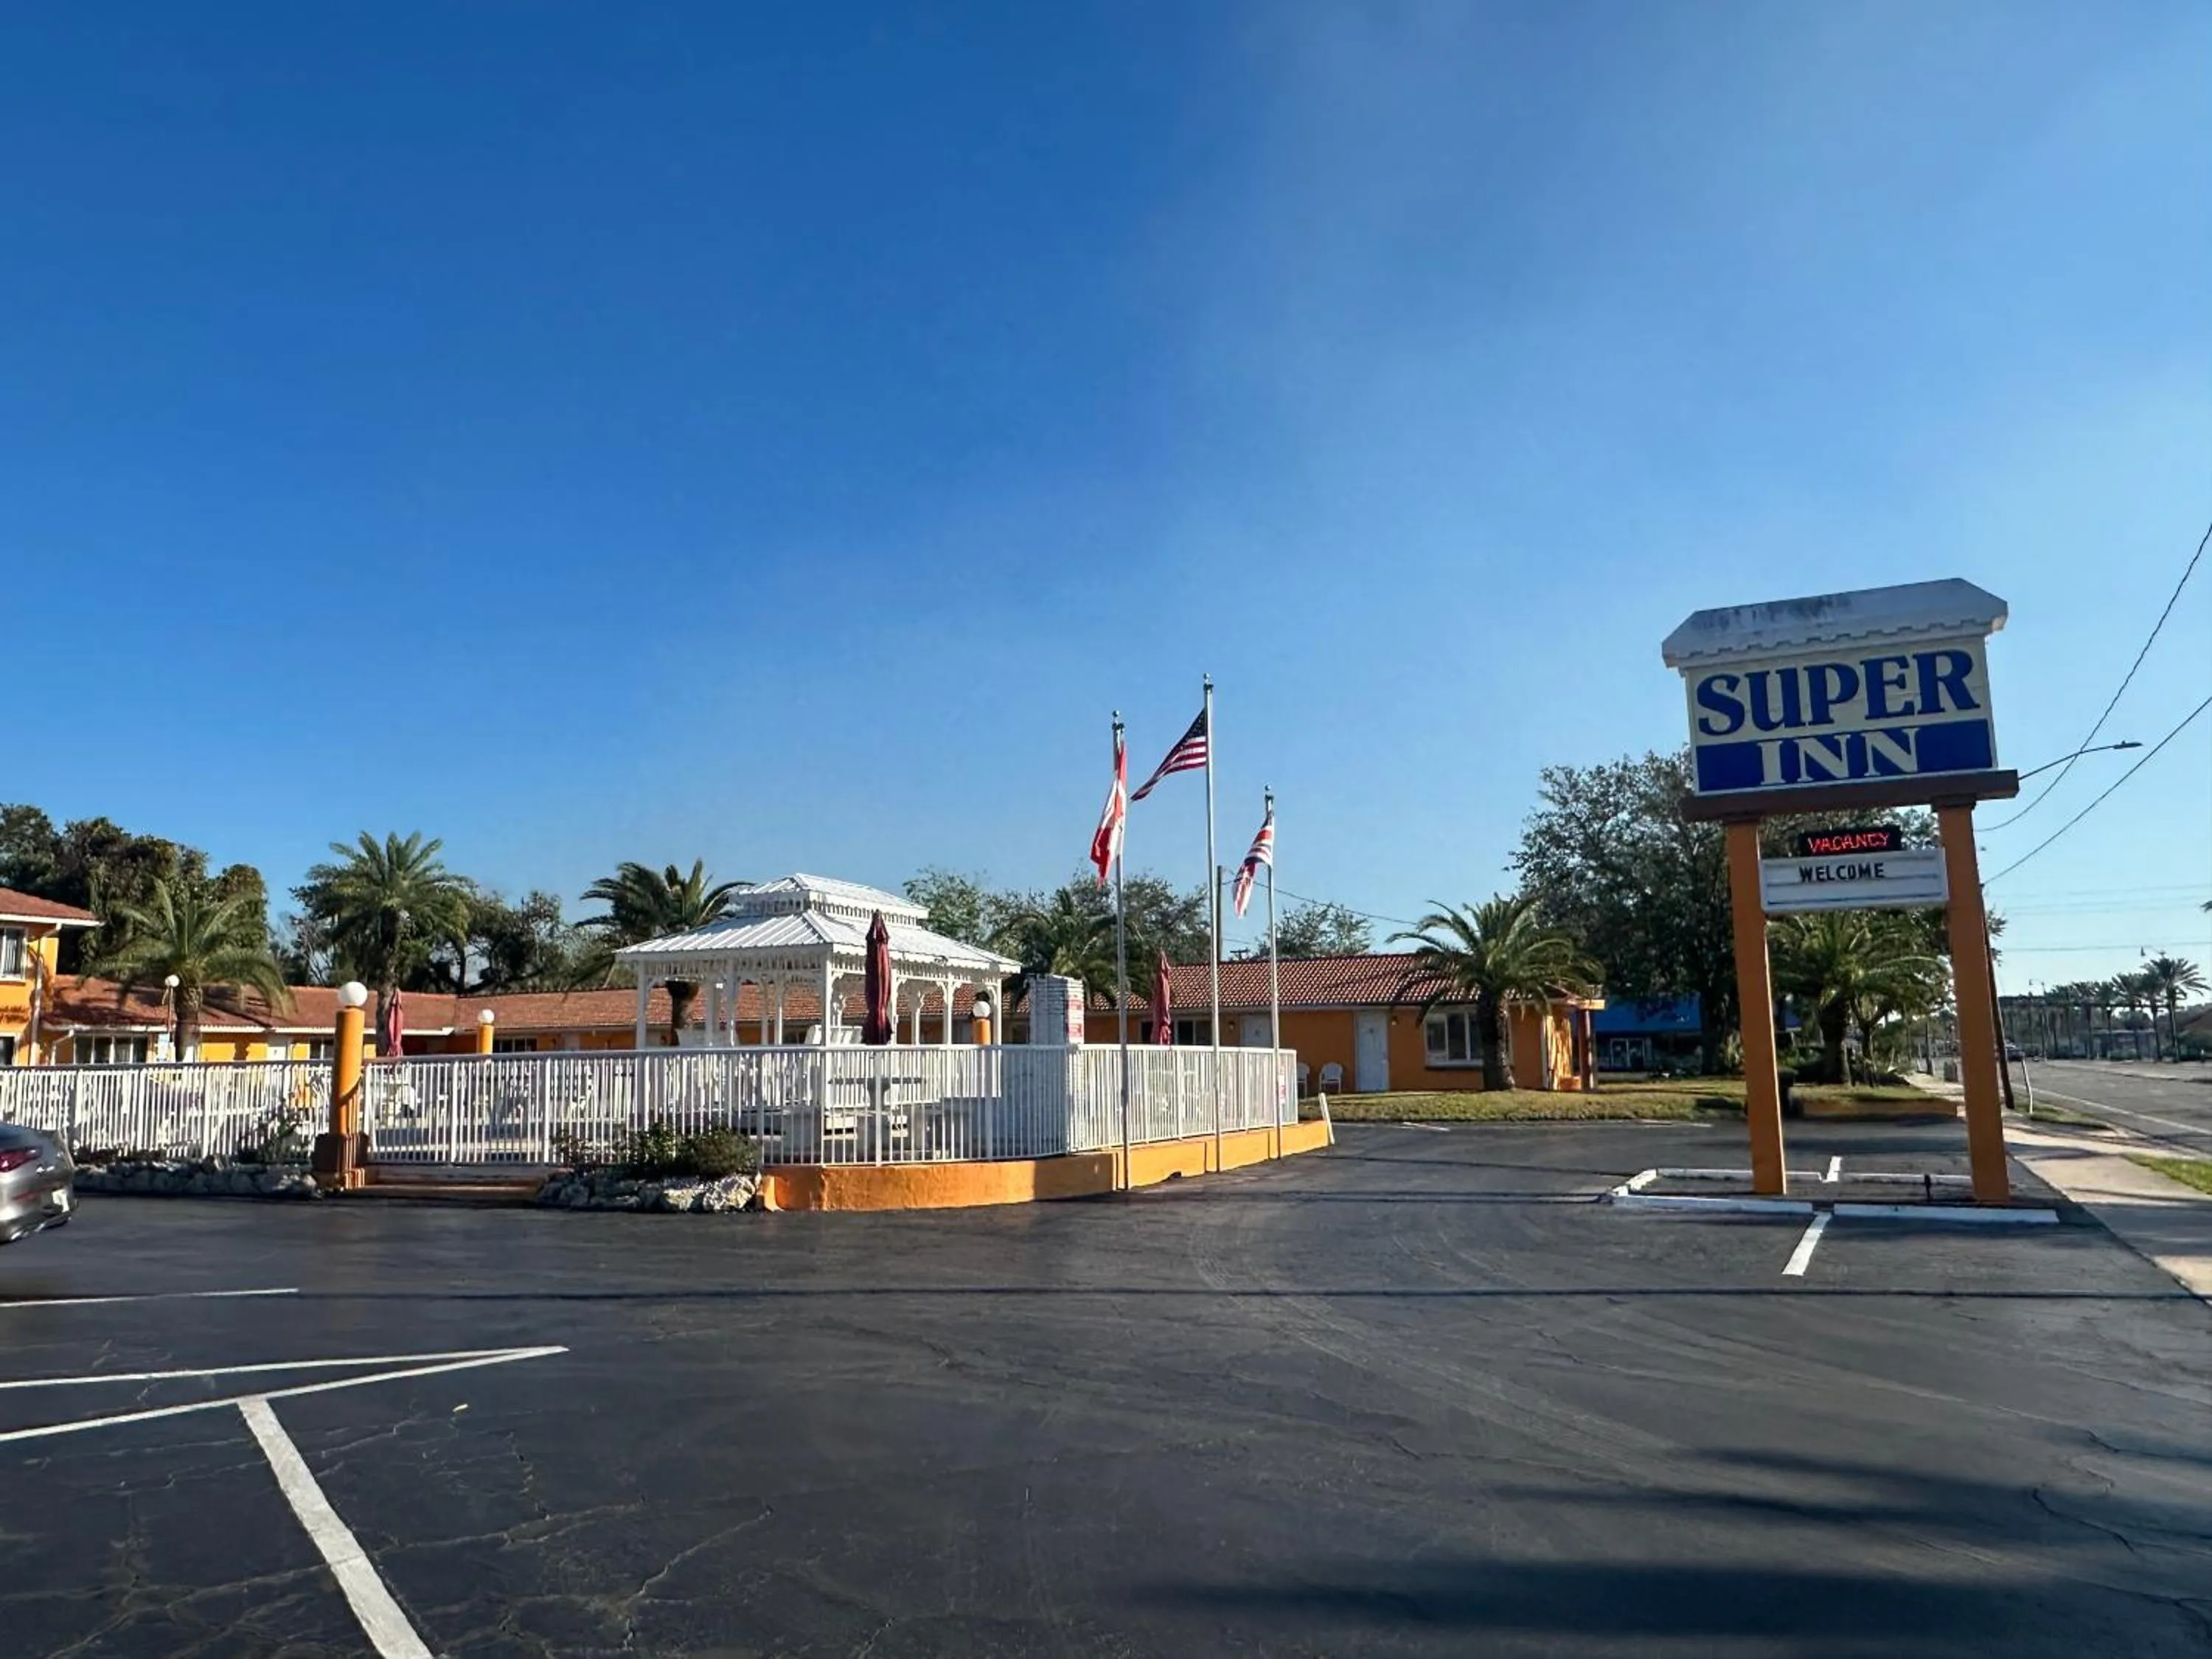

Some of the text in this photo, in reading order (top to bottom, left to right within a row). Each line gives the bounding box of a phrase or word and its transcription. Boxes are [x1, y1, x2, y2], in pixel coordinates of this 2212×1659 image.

[1697, 649, 1980, 736] SUPER
[1758, 728, 1920, 786] INN
[1807, 832, 1889, 853] VACANCY
[1799, 862, 1885, 883] WELCOME
